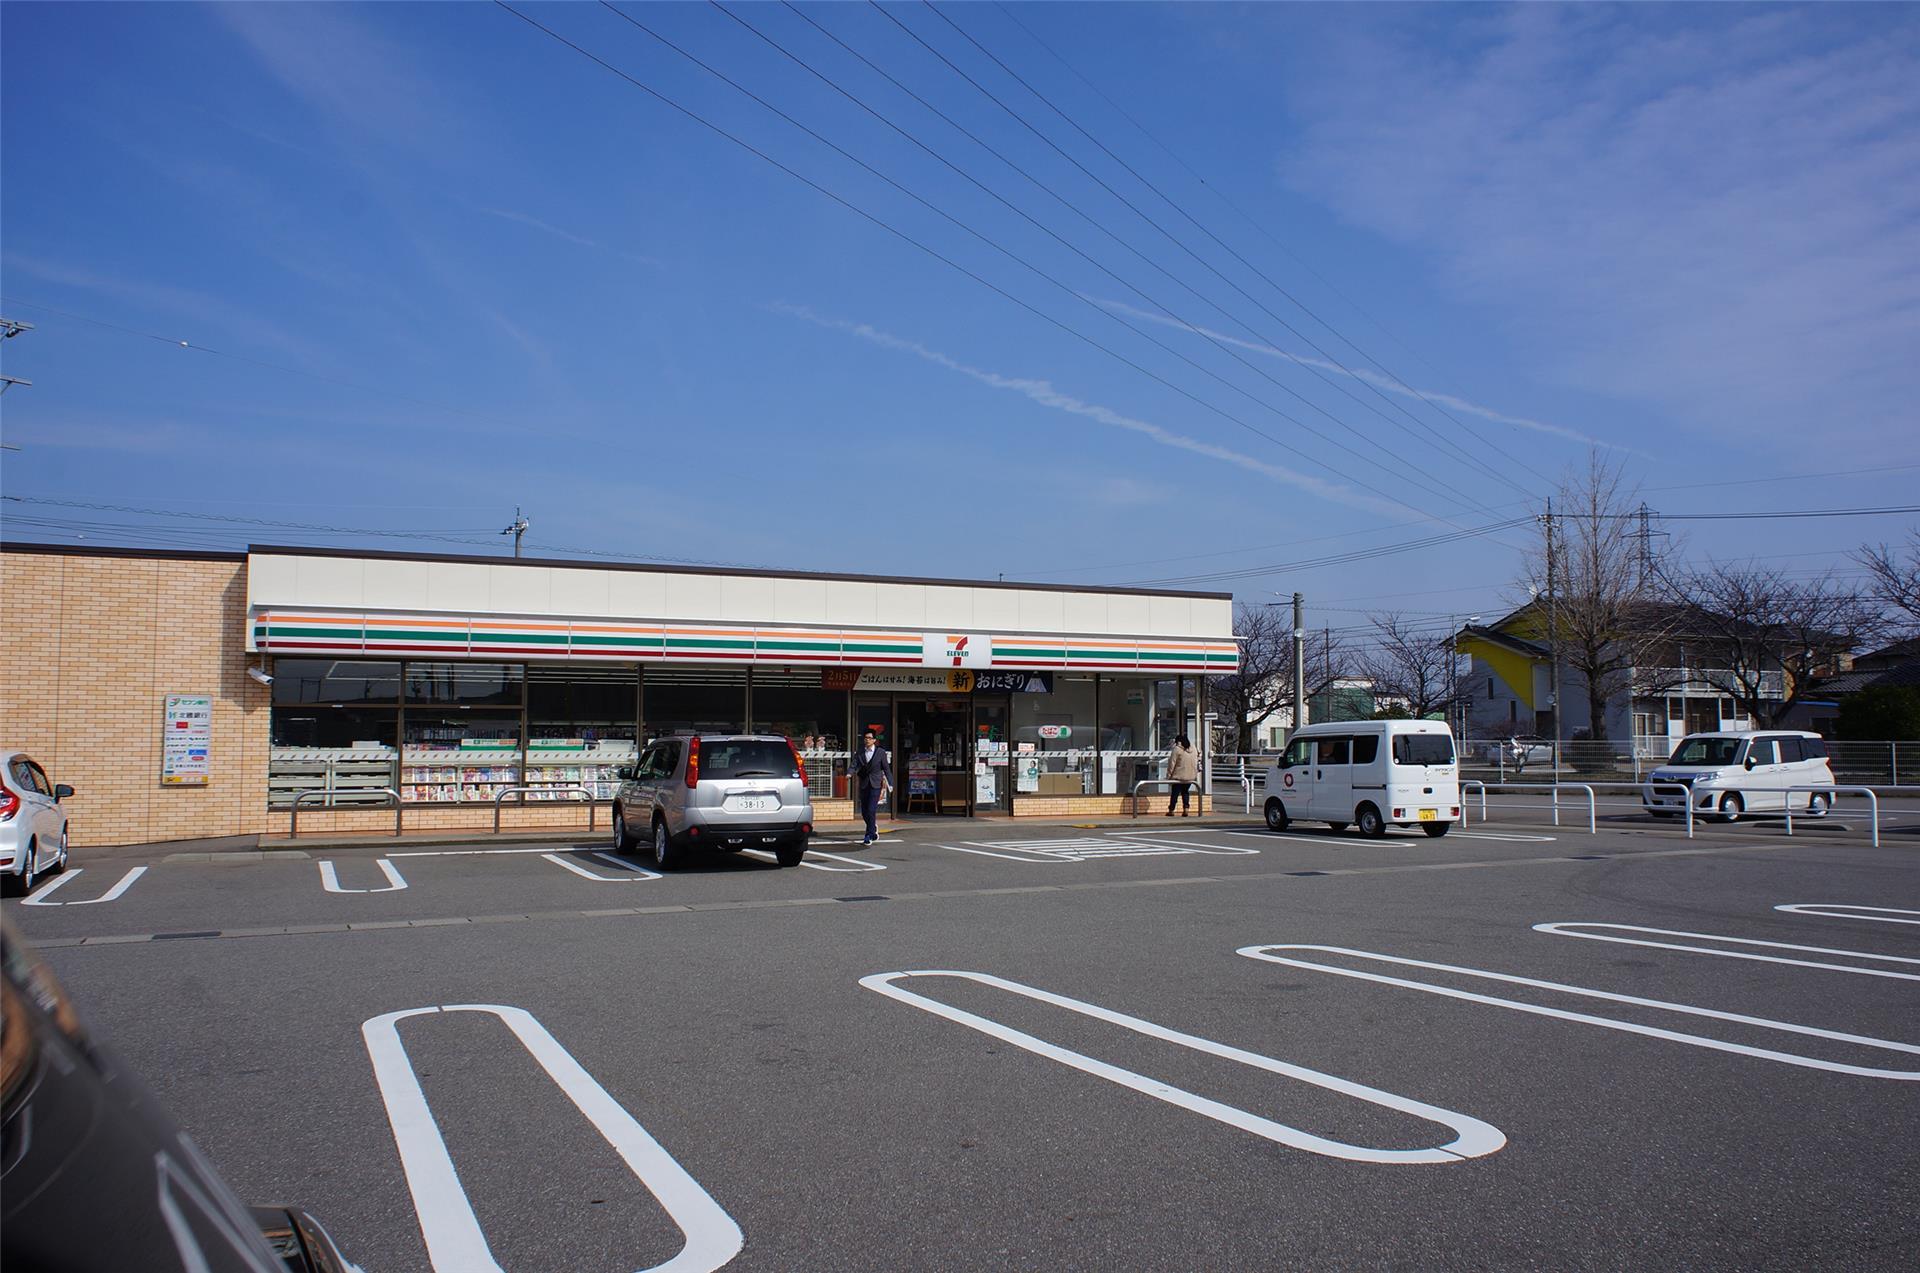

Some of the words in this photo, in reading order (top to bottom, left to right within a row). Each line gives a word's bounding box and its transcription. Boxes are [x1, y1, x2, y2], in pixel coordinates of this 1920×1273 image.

[952, 672, 970, 690] 新
[976, 672, 1025, 690] おにぎり
